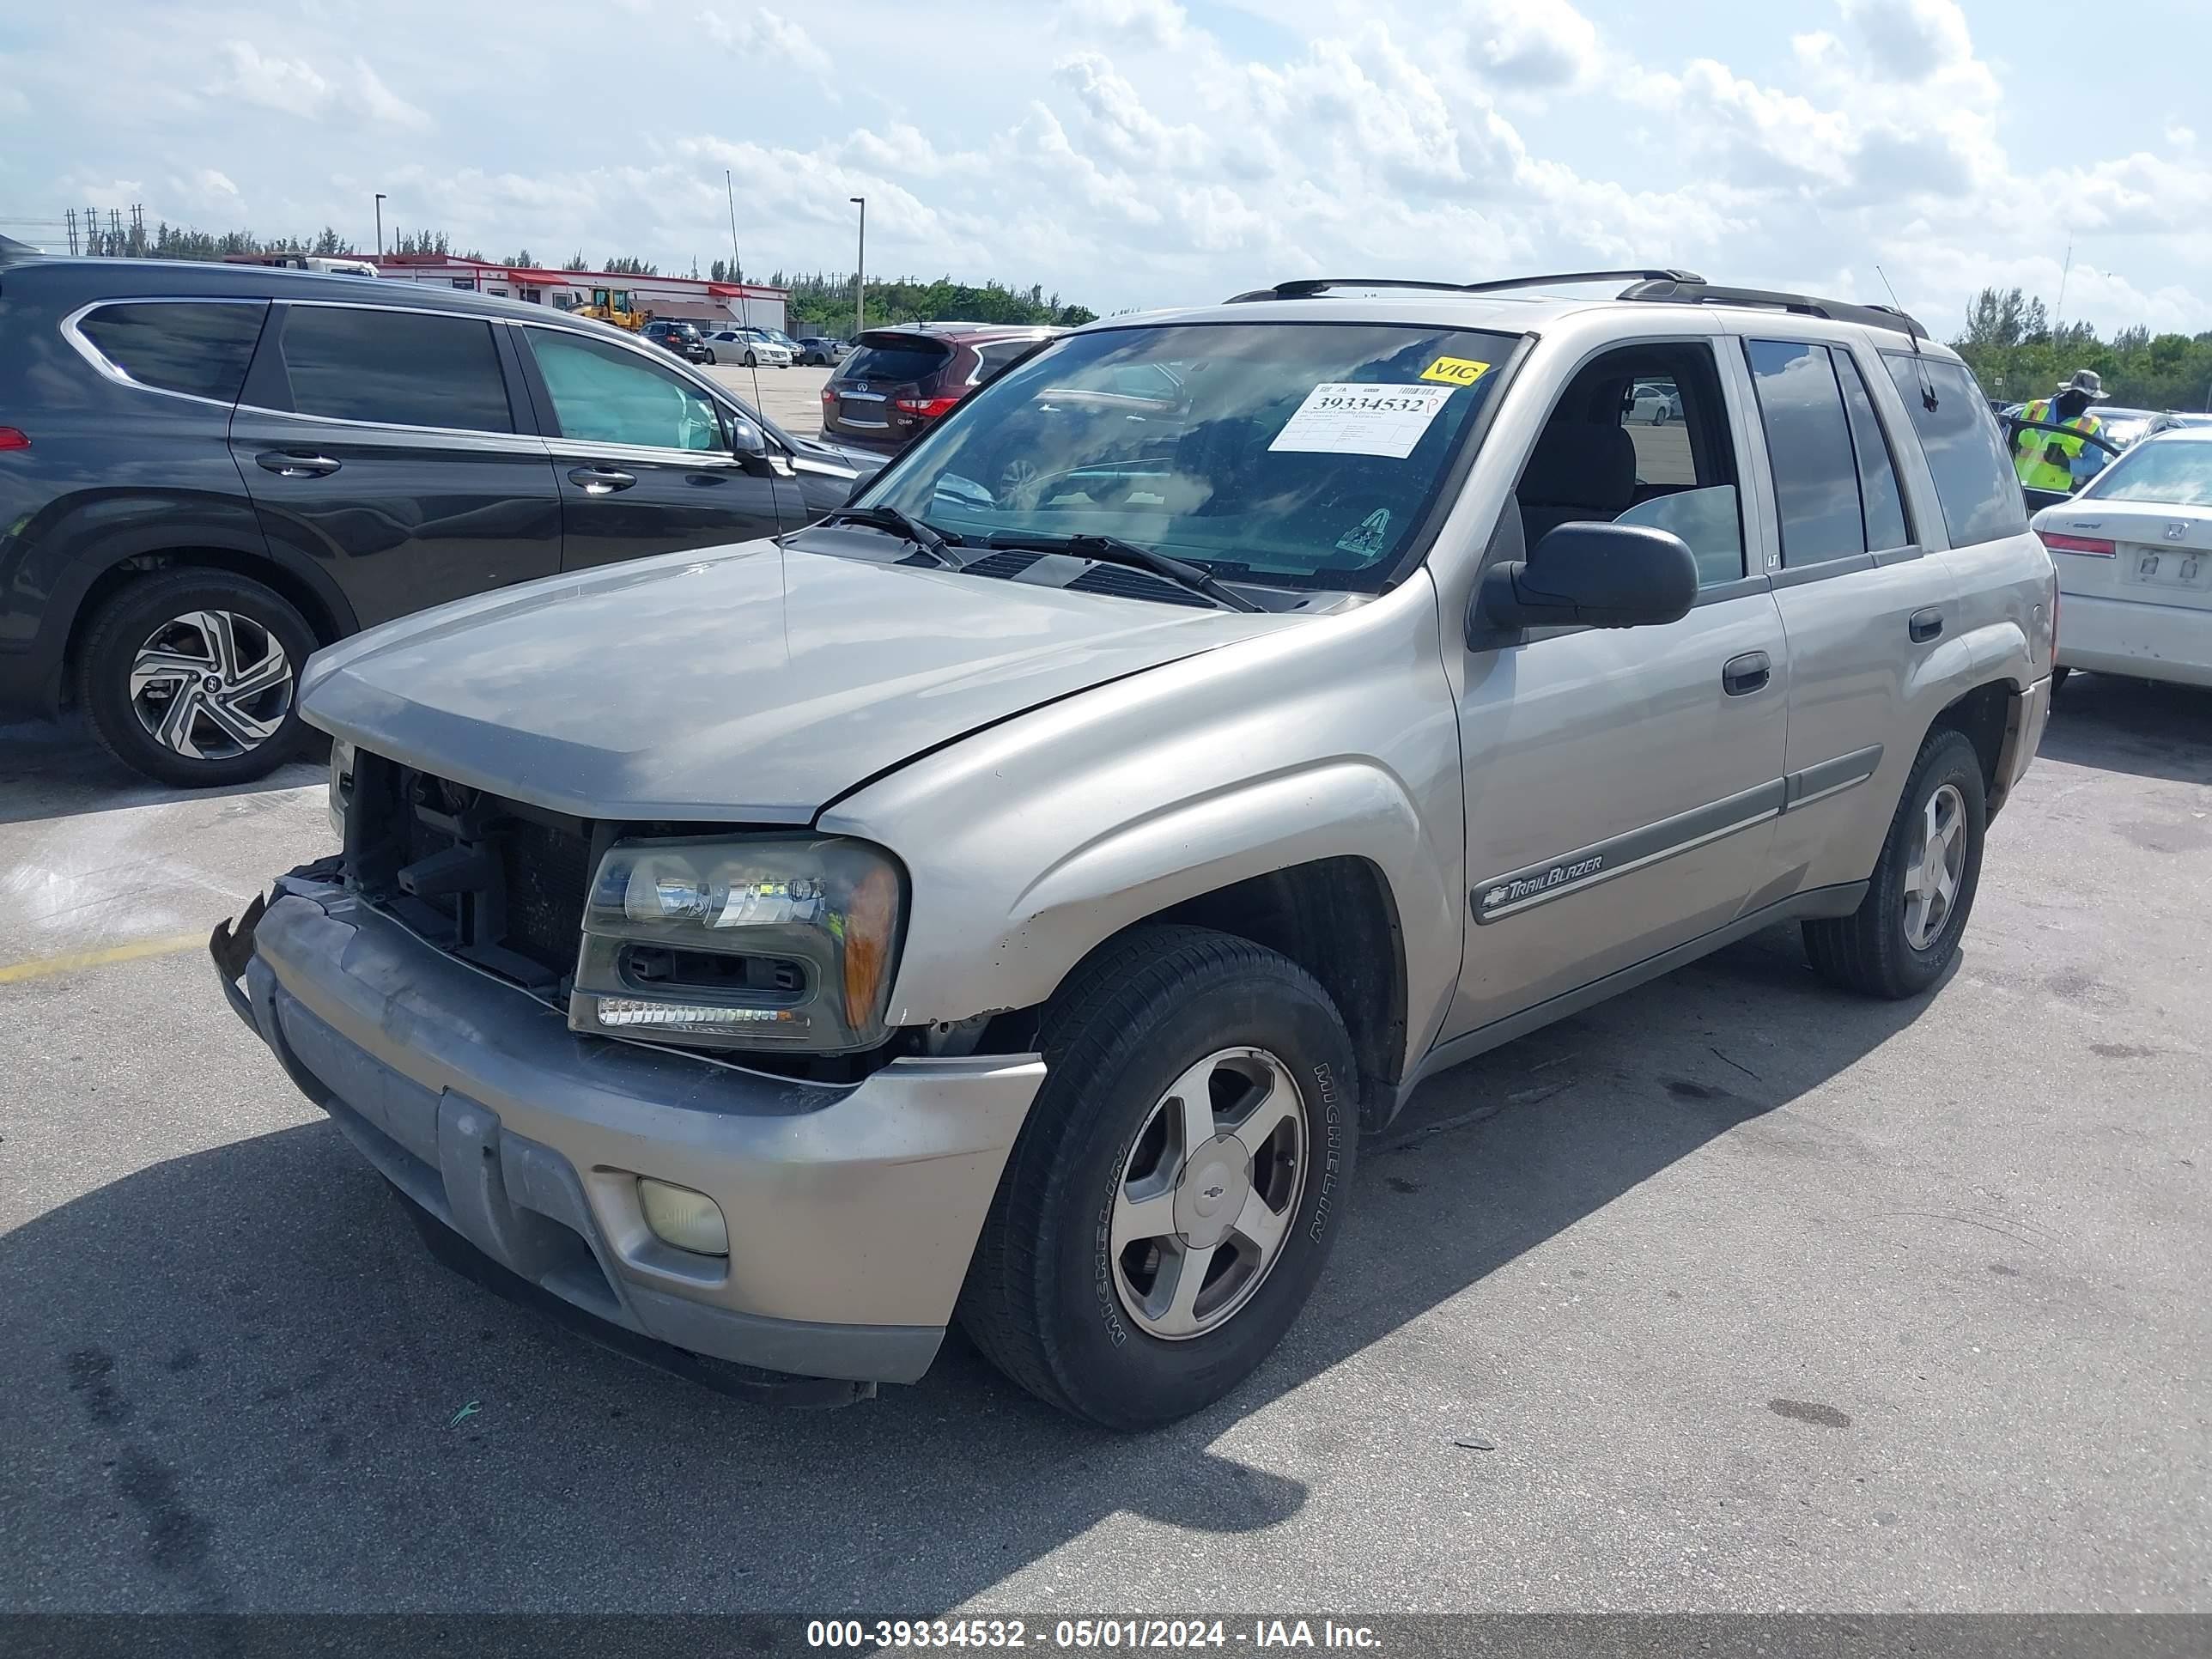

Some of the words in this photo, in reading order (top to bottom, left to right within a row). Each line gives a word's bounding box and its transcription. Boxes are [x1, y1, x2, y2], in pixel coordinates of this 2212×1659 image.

[1435, 362, 1479, 379] VIC
[1313, 398, 1425, 412] 39334532
[1767, 554, 1778, 568] LT
[1310, 1061, 1342, 1244] MICHELIN
[1093, 1142, 1128, 1348] MICHELIN
